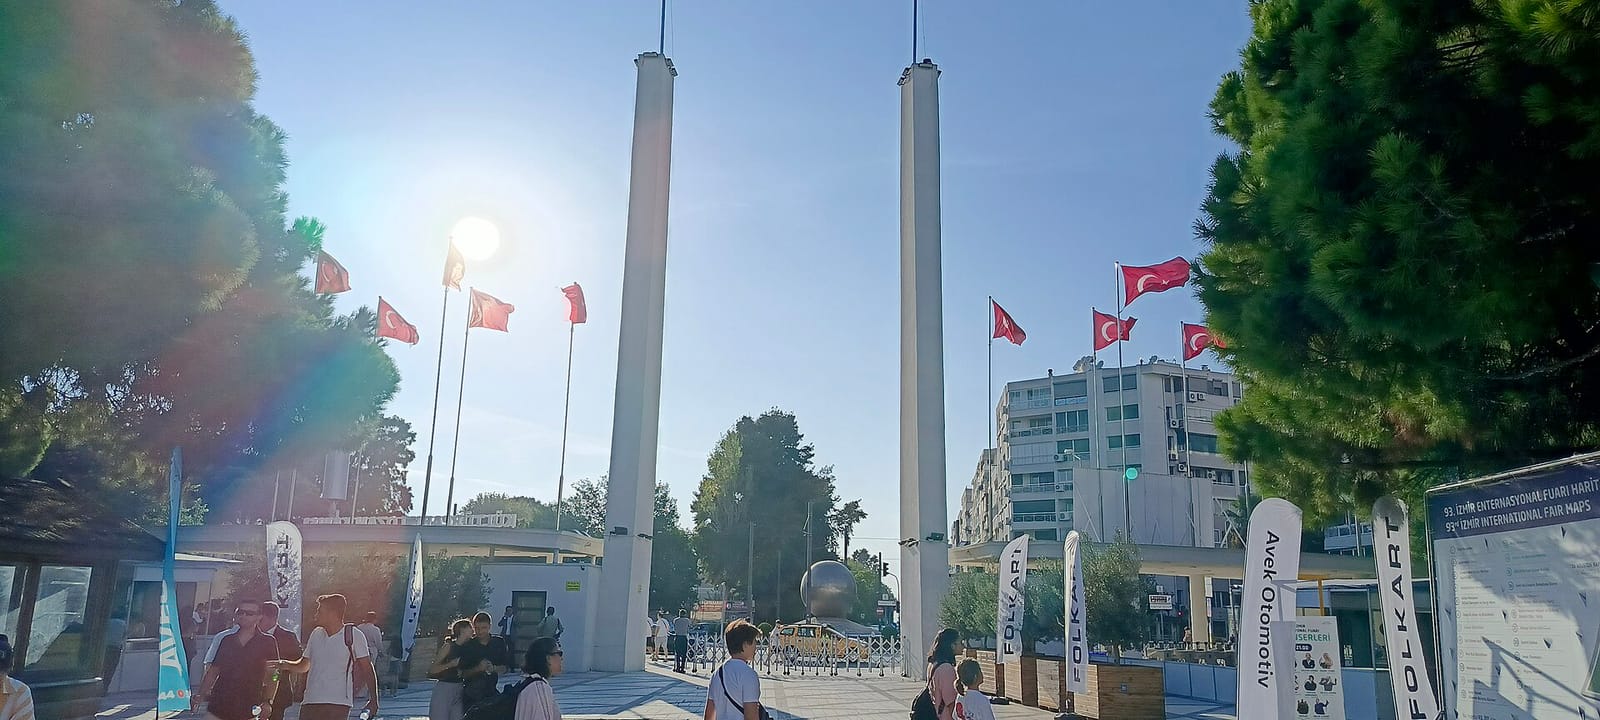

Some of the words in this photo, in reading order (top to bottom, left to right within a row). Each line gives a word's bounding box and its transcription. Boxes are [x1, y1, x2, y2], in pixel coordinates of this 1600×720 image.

[1444, 506, 1456, 517] 93.
[1456, 501, 1476, 515] İZMİR
[1477, 490, 1542, 511] ENTERNASYONAL
[1543, 483, 1570, 501] FUARI
[1460, 515, 1480, 530] İZMİR
[1480, 507, 1543, 528] INTERNATIONAL
[1543, 504, 1564, 518] FAIR
[1565, 499, 1592, 514] MAPS
[1263, 530, 1280, 581] Avek
[1257, 587, 1276, 689] Otomotiv
[1385, 516, 1427, 719] FOLKART
